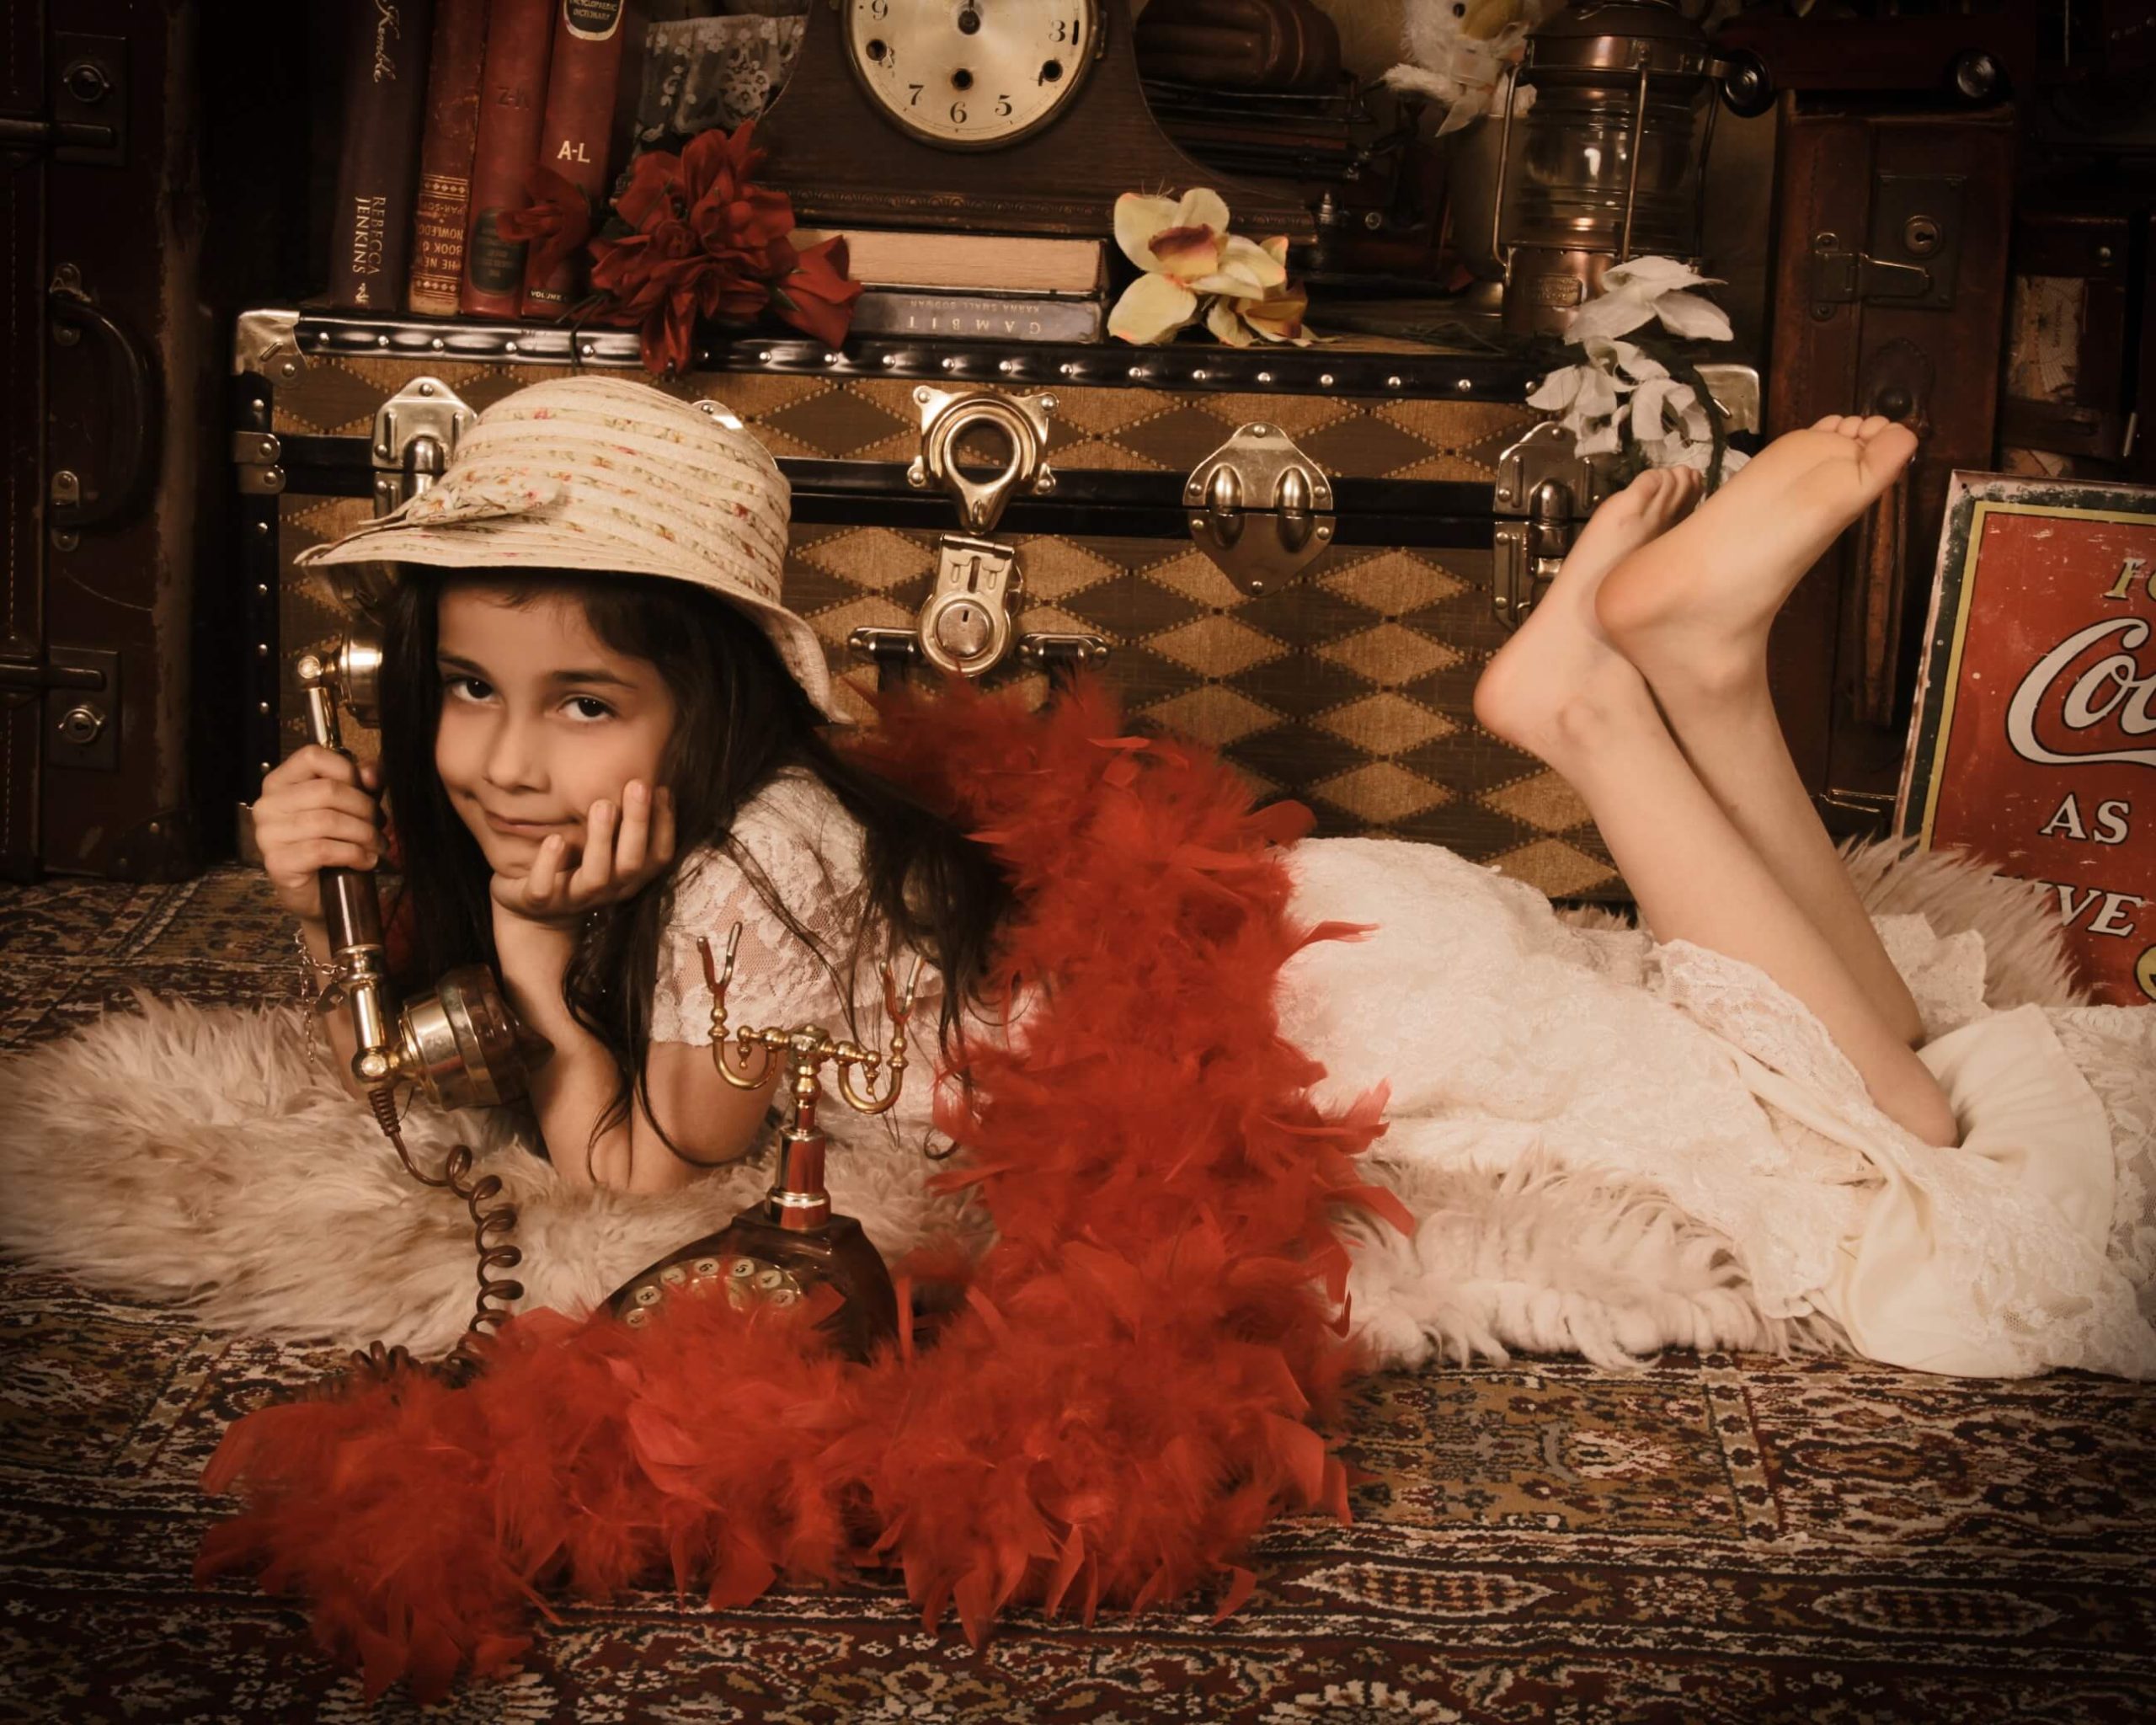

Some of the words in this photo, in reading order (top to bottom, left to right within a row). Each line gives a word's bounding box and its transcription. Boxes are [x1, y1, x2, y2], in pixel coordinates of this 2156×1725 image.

[872, 0, 889, 20] 9
[373, 0, 400, 83] Kemble
[1048, 20, 1066, 43] 3
[909, 83, 925, 106] 7
[995, 94, 1012, 116] 5
[950, 101, 967, 124] 6
[557, 141, 590, 163] A-L
[352, 196, 371, 274] JENKINS
[367, 196, 387, 275] REBECCA
[419, 225, 464, 241] NOWLEDG
[434, 242, 462, 256] BOOK
[531, 290, 563, 302] VOLUME
[963, 302, 997, 312] SMALL
[907, 316, 1041, 334] GAMBIT
[2038, 792, 2131, 845] AS
[699, 1263, 713, 1272] 6
[735, 1264, 749, 1273] 5
